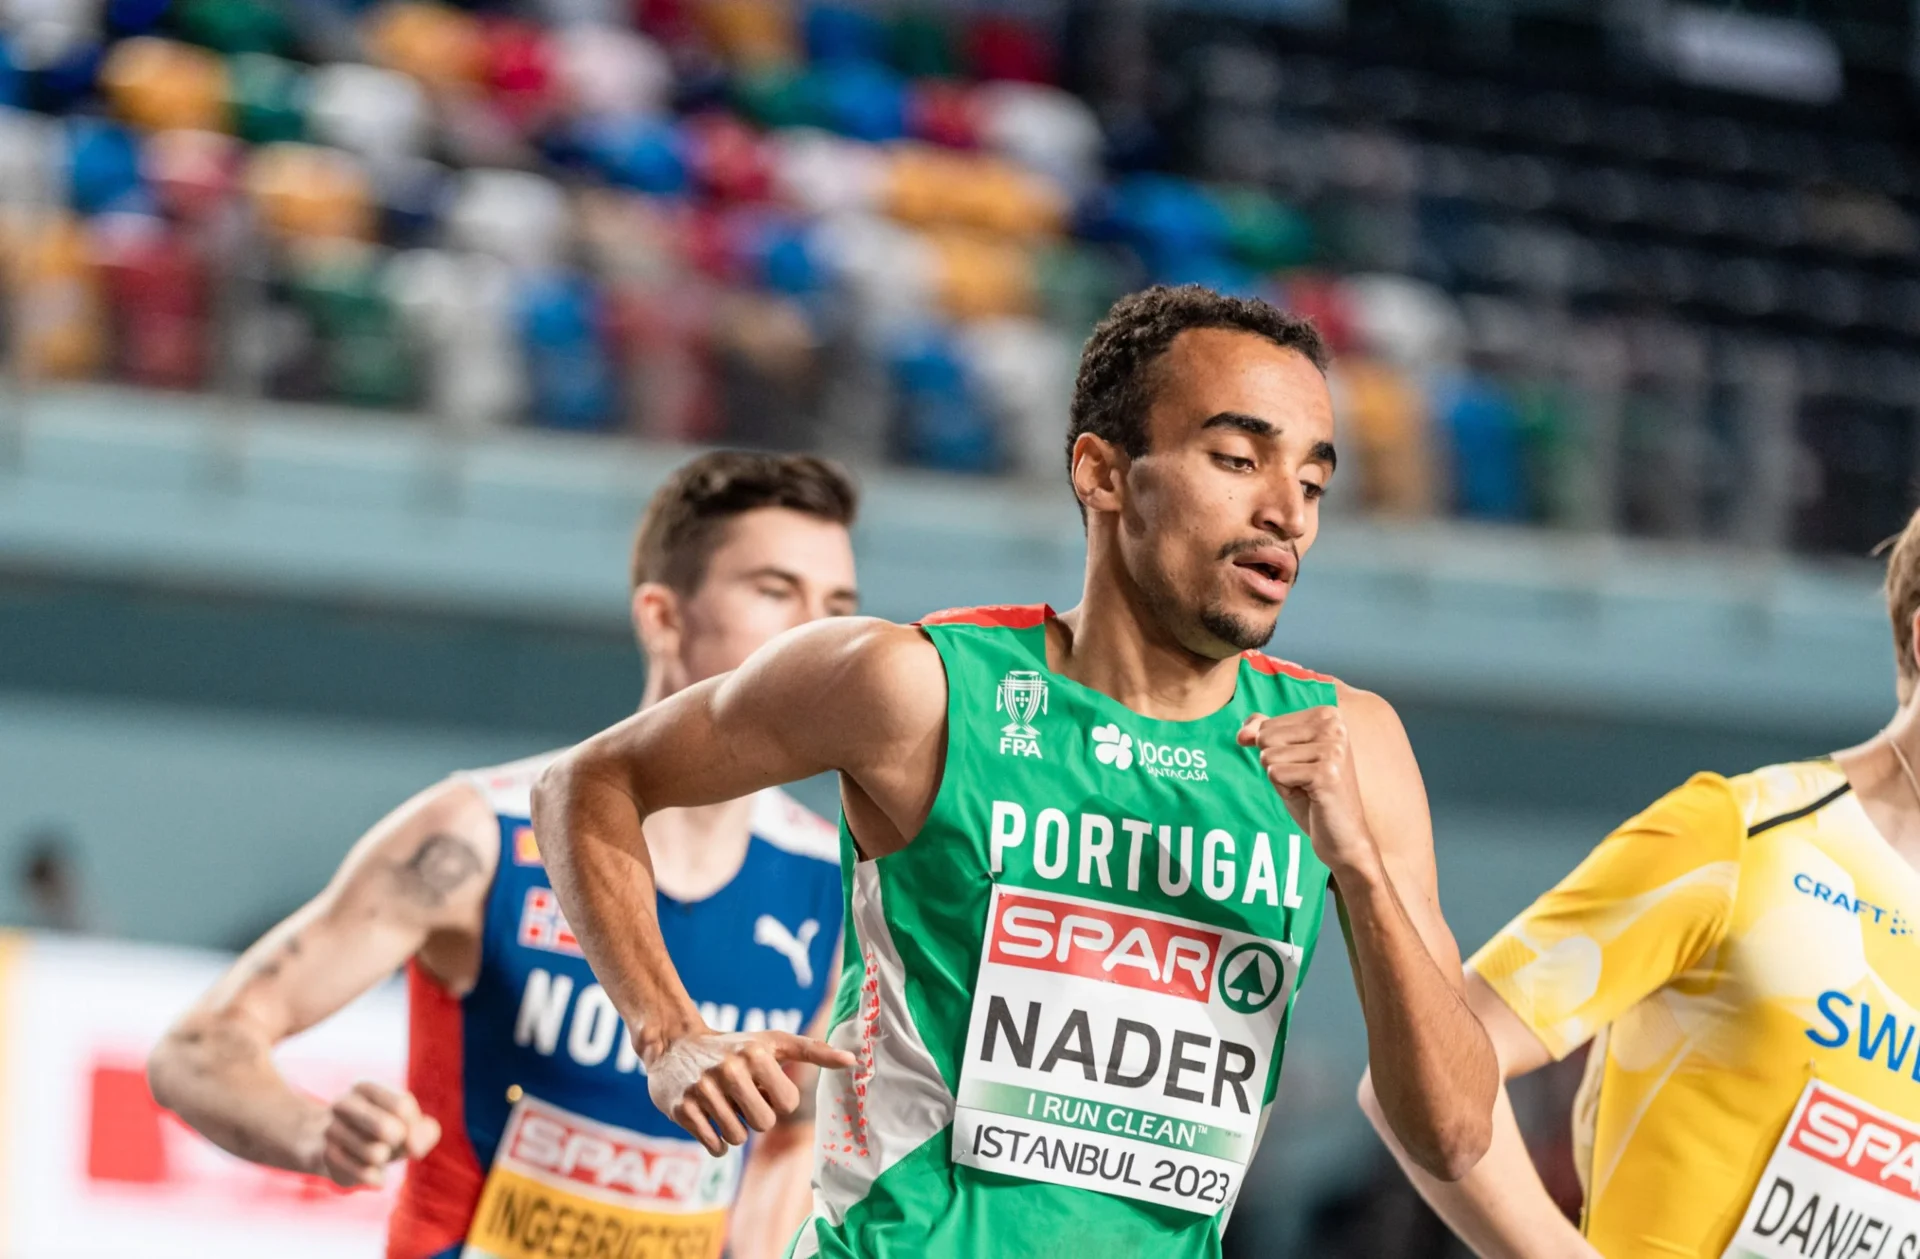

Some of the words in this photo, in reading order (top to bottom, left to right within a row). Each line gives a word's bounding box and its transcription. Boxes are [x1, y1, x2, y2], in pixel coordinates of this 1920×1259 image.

[999, 737, 1043, 759] FPA
[1137, 738, 1207, 768] JOGOS
[990, 800, 1303, 910] PORTUGAL
[1793, 873, 1887, 923] CRAFT
[998, 905, 1210, 991] SPAR
[980, 995, 1256, 1115] NADER
[1805, 990, 1920, 1083] SW
[1027, 1093, 1036, 1115] I
[1043, 1096, 1101, 1127] RUN
[515, 1115, 698, 1200] SPAR
[973, 1124, 1142, 1186] ISTANBUL
[1149, 1160, 1230, 1204] 2023
